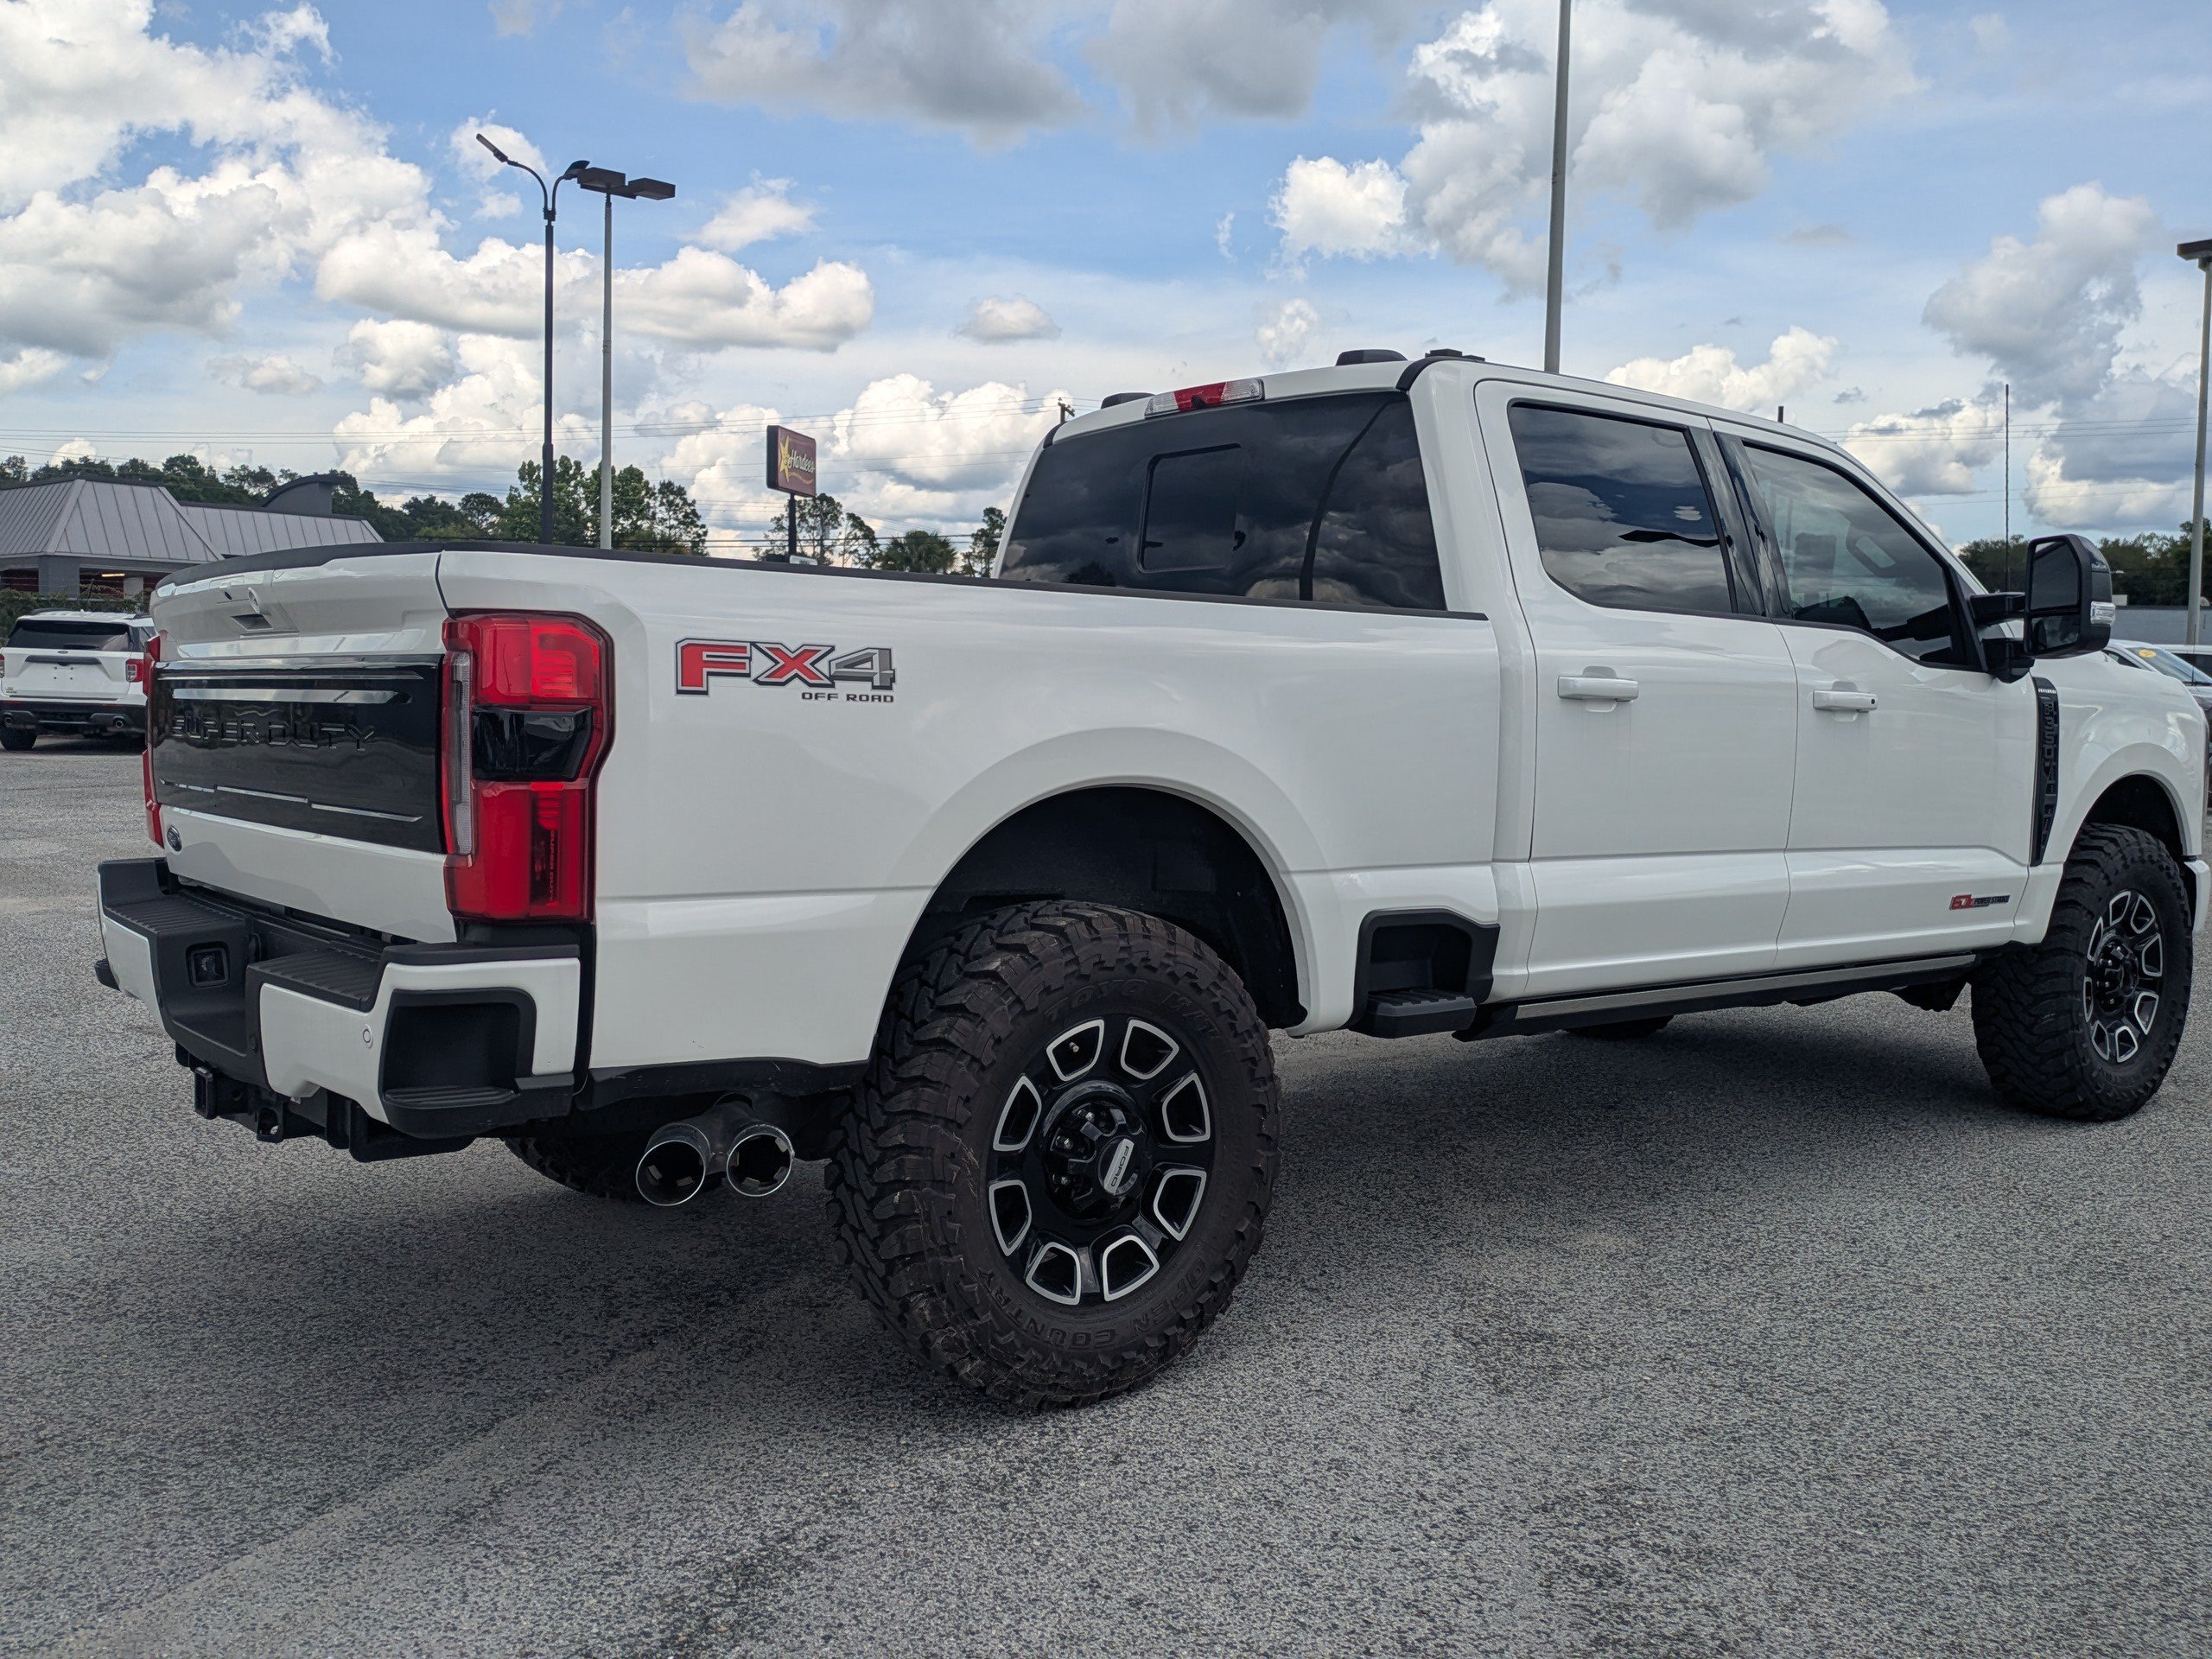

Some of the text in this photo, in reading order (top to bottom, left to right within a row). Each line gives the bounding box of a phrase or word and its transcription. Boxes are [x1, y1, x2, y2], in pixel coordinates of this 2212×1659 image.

[787, 448, 816, 474] Hardee's
[675, 637, 896, 696] FX4
[801, 691, 894, 703] OFF ROAD
[171, 716, 376, 753] SUPER DUTY
[1110, 1145, 1130, 1188] FORD
[975, 1257, 1208, 1350] OPEN COUNTRY
